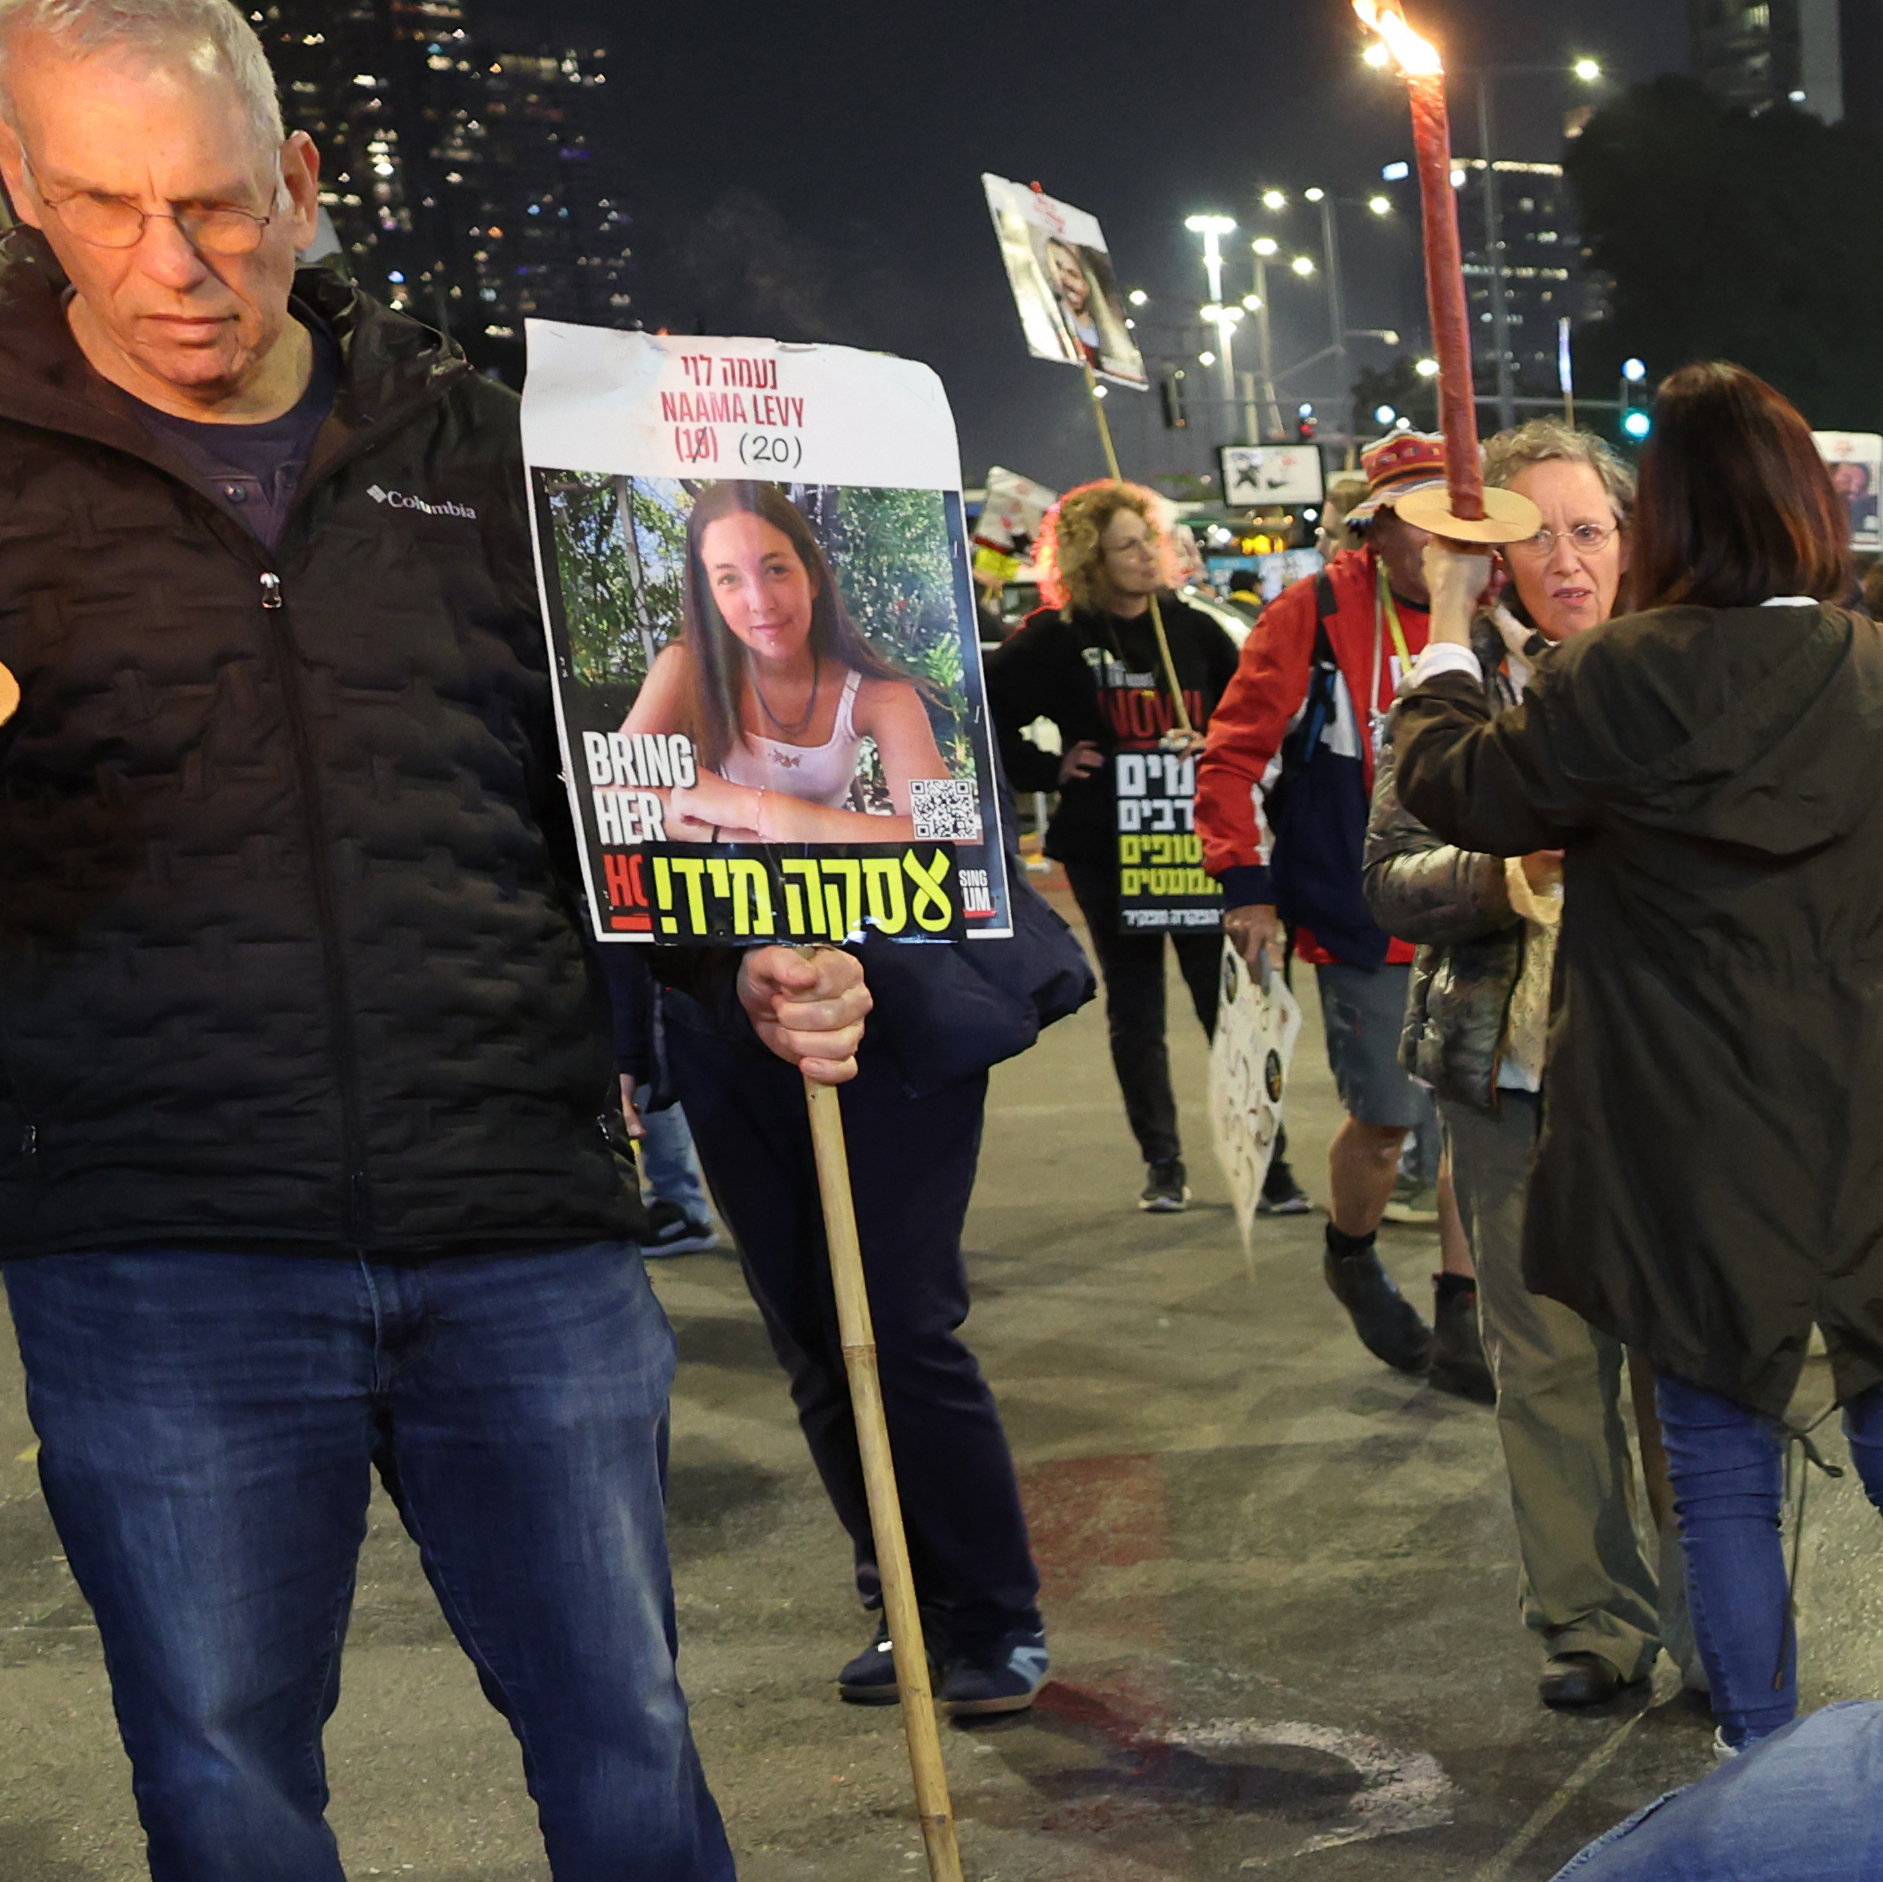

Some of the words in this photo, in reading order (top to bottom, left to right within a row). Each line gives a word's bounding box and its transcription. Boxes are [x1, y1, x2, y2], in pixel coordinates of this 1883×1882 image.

[681, 354, 713, 386] לוי
[720, 357, 778, 390] נעמה
[661, 391, 748, 424] NAAMA
[752, 394, 804, 428] LEVY
[739, 432, 802, 469] (20)
[387, 490, 477, 519] Columbia
[582, 731, 697, 788] BRING
[592, 791, 667, 845] HER
[652, 856, 775, 936] מיד!
